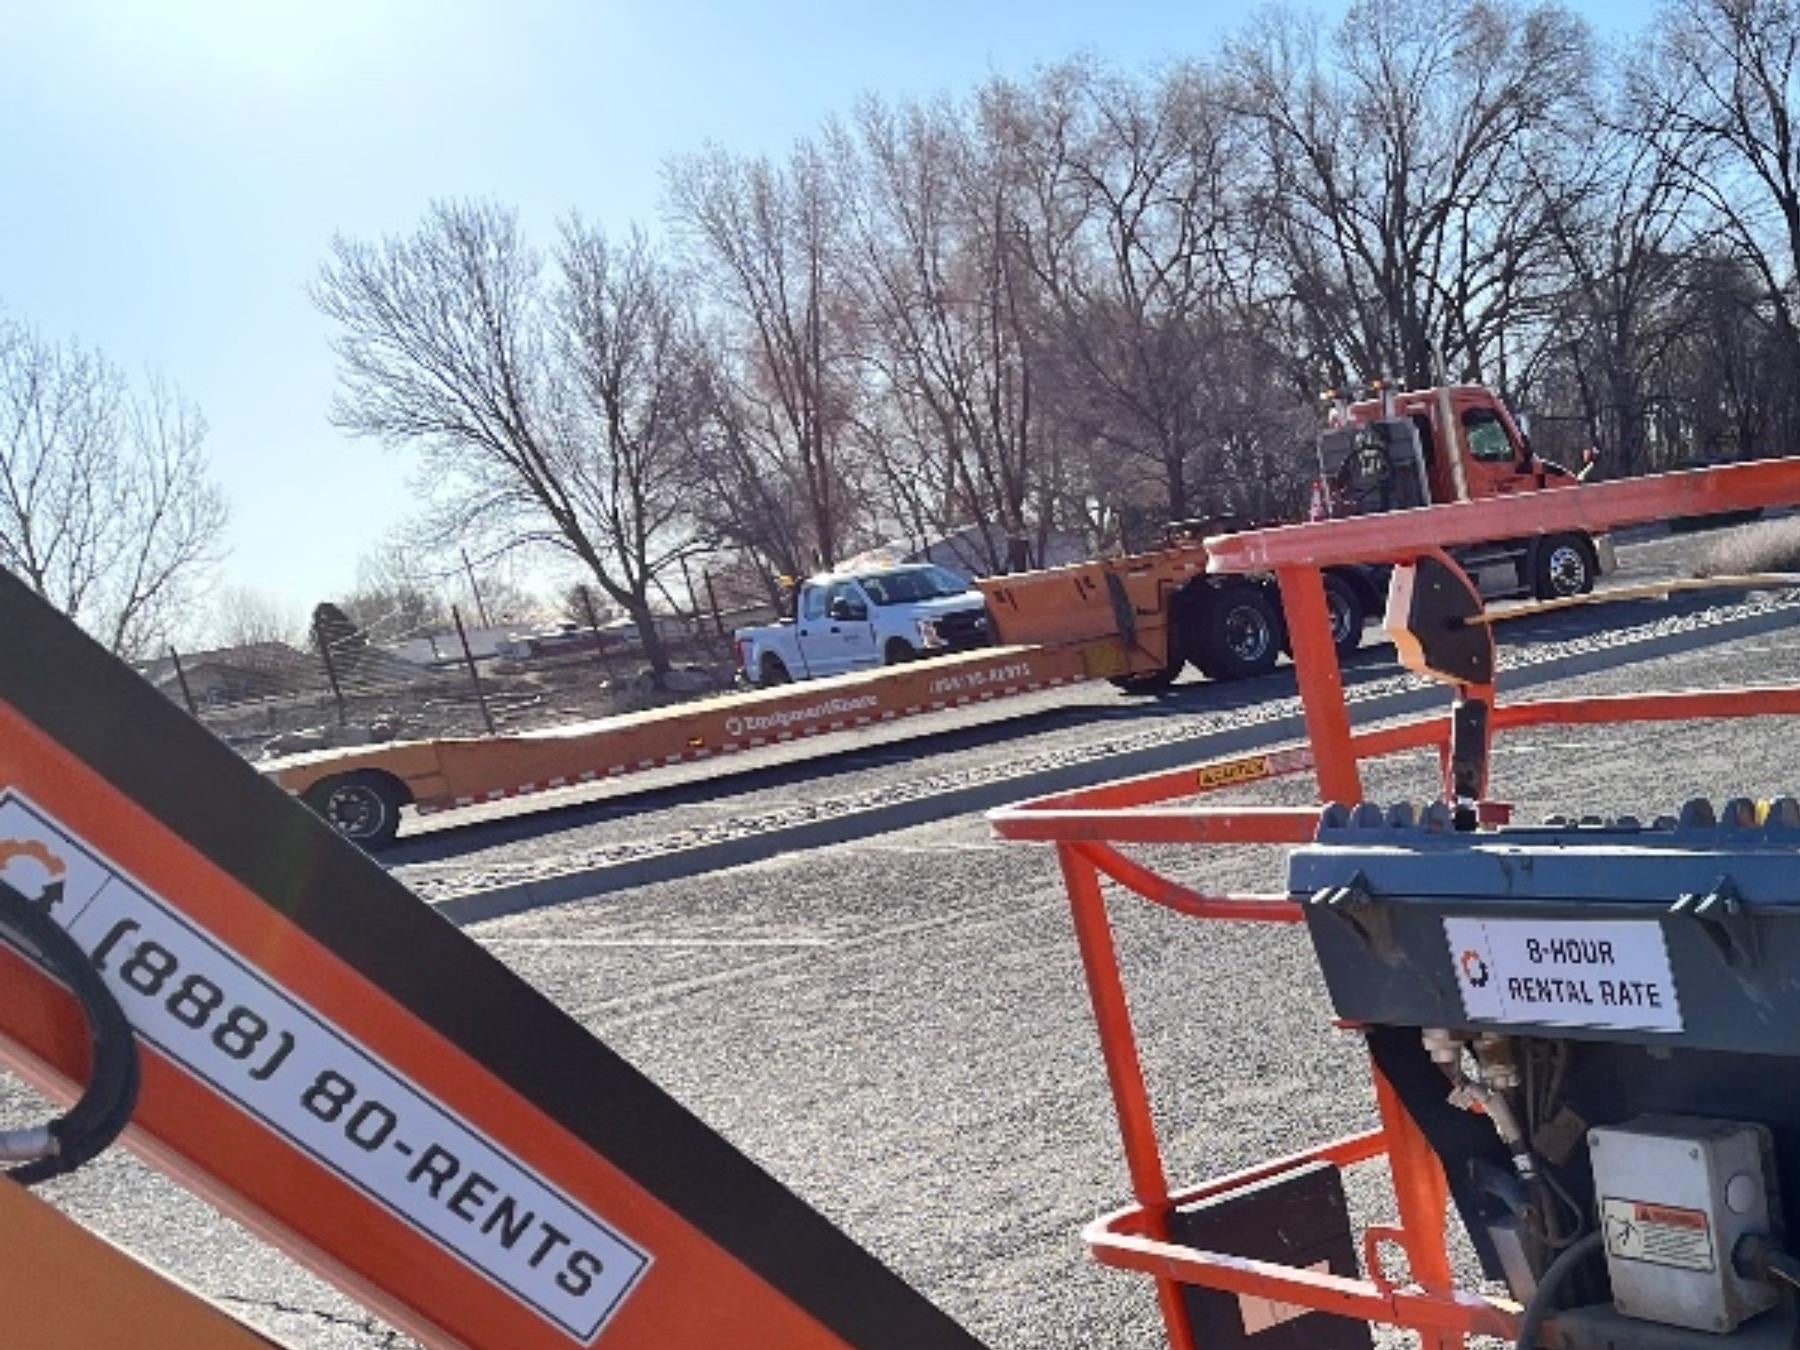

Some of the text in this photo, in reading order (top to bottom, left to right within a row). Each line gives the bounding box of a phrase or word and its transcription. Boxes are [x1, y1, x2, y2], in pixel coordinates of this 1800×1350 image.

[1526, 938, 1615, 966] 8-HOUR
[1507, 976, 1663, 1008] RENTAL RATE
[93, 917, 605, 1299] (888) 80-RENTS
